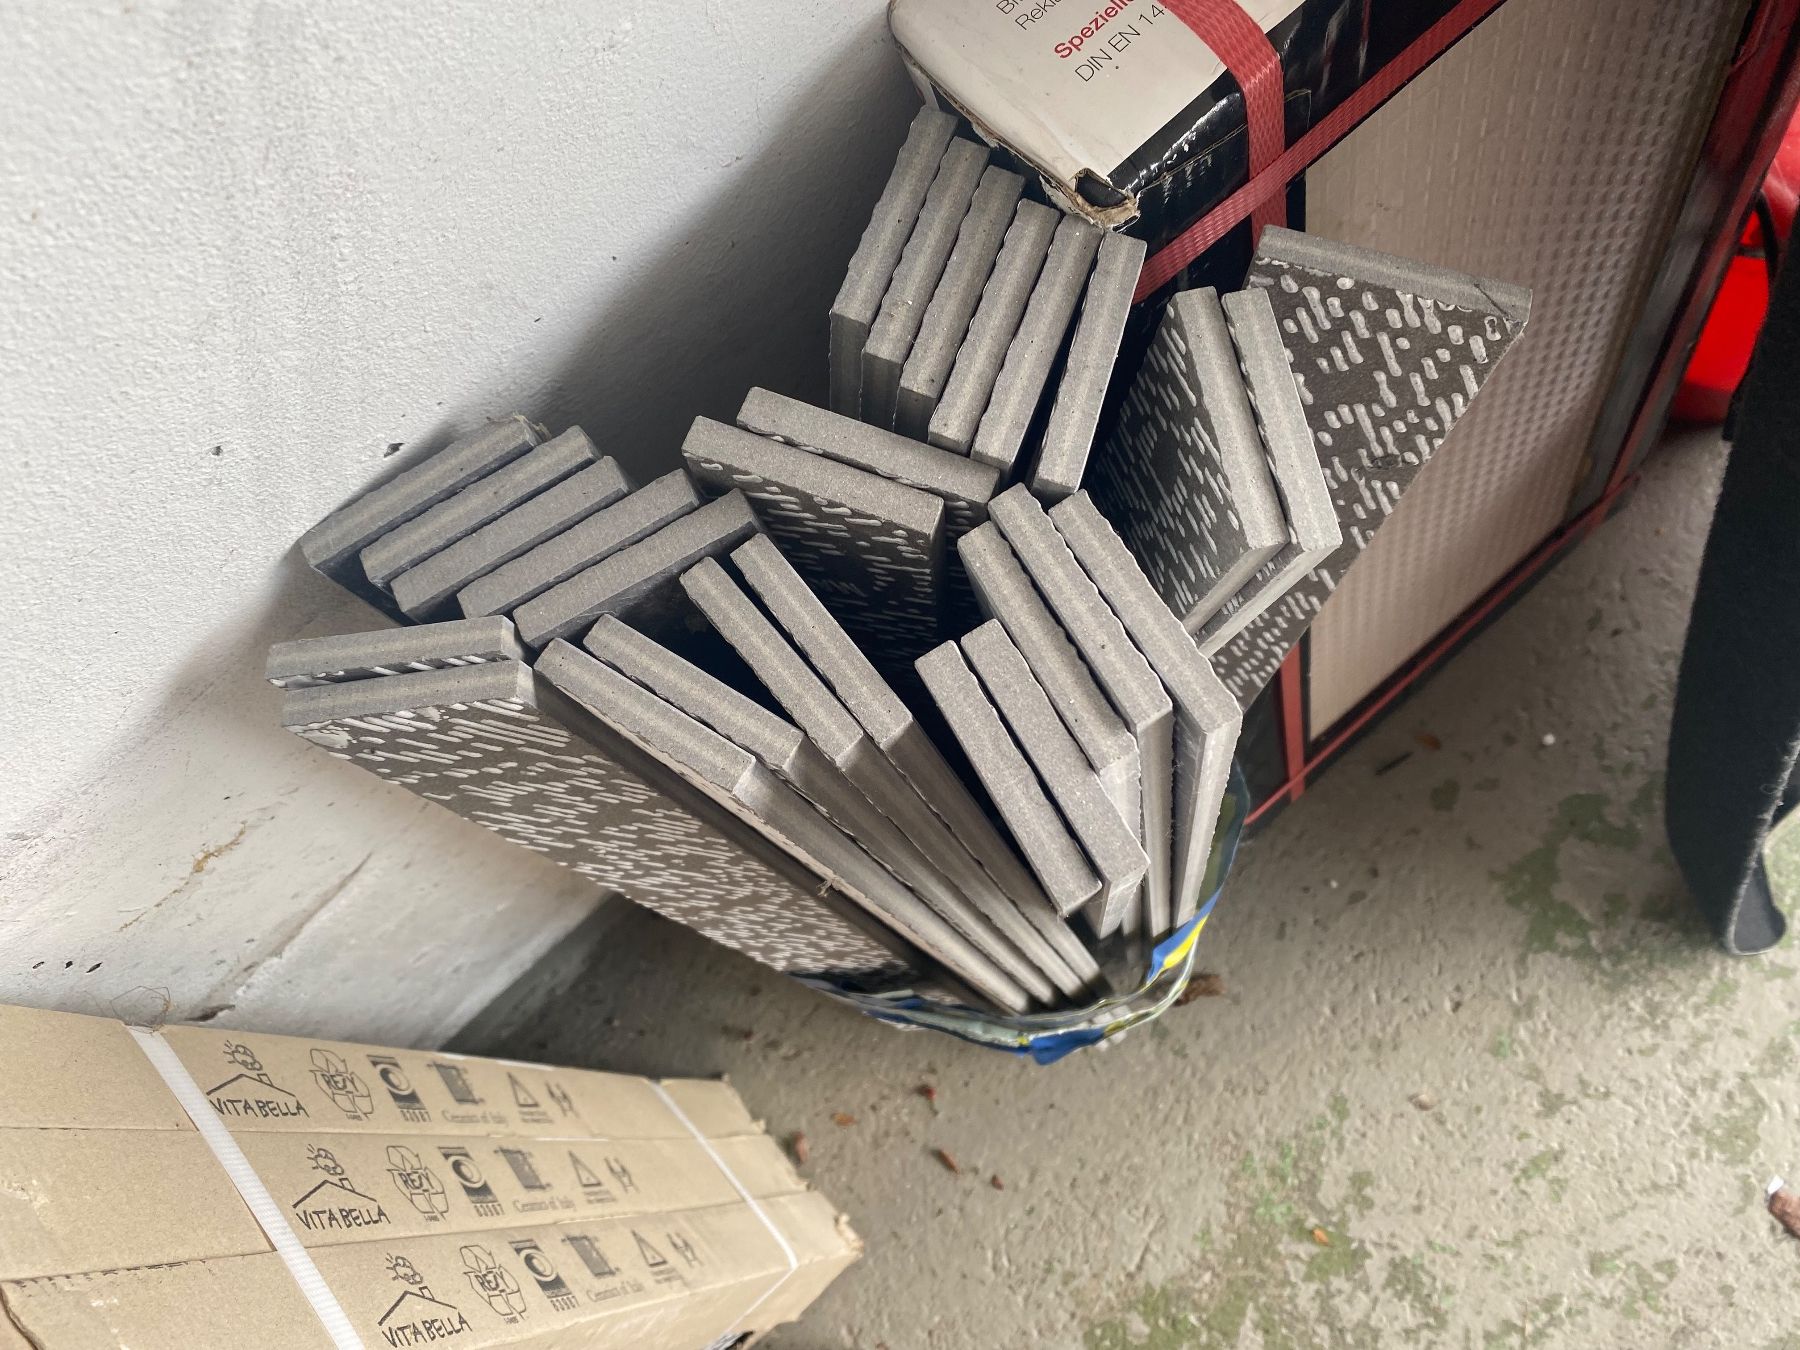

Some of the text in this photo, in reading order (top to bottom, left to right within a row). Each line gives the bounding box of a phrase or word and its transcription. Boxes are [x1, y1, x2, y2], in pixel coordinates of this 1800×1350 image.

[1053, 0, 1135, 59] Speziell
[1074, 4, 1167, 82] DIN EN 14
